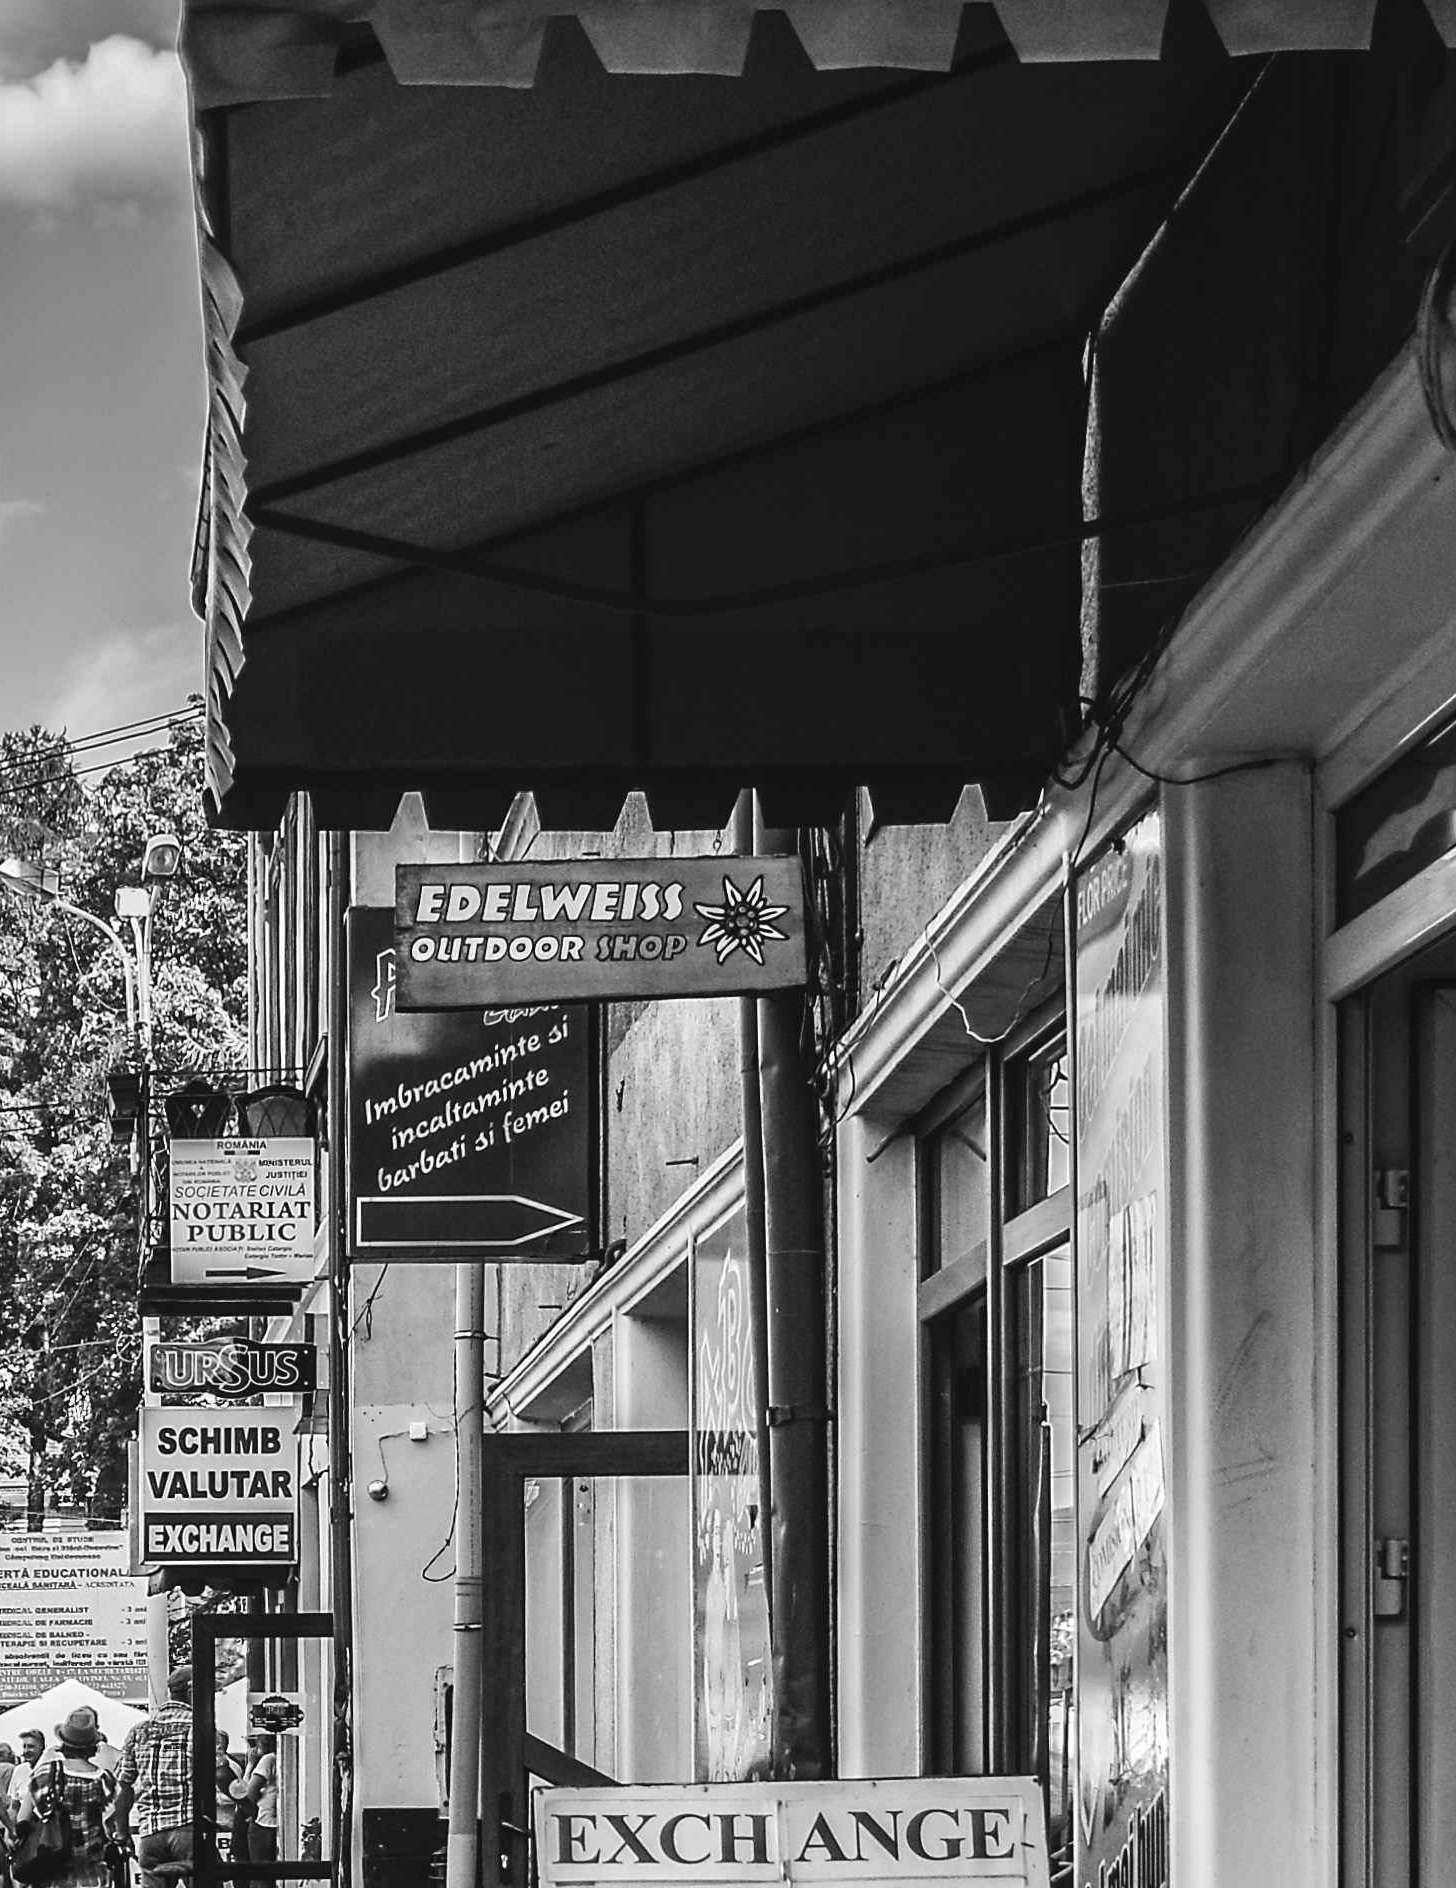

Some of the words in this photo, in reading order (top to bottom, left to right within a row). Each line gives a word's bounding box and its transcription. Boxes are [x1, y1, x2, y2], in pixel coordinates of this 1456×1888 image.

[415, 882, 685, 923] EDELWEISS
[410, 934, 585, 965] OUTDOOR
[594, 934, 687, 963] SHOP
[364, 1033, 542, 1126] Imbracaminte
[548, 1013, 569, 1045] si
[391, 1068, 550, 1151] incaltaminte
[377, 1133, 467, 1192] barbati
[474, 1121, 495, 1152] si
[502, 1089, 569, 1144] femei
[258, 1159, 313, 1167] MINISTERUL
[171, 1201, 311, 1221] NOTARIAT
[187, 1223, 297, 1242] PUBLIC
[163, 1349, 299, 1391] URSUS
[158, 1427, 282, 1455] SCHIMB
[146, 1469, 293, 1501] VALUTAR
[148, 1525, 290, 1555] EXCHANGE
